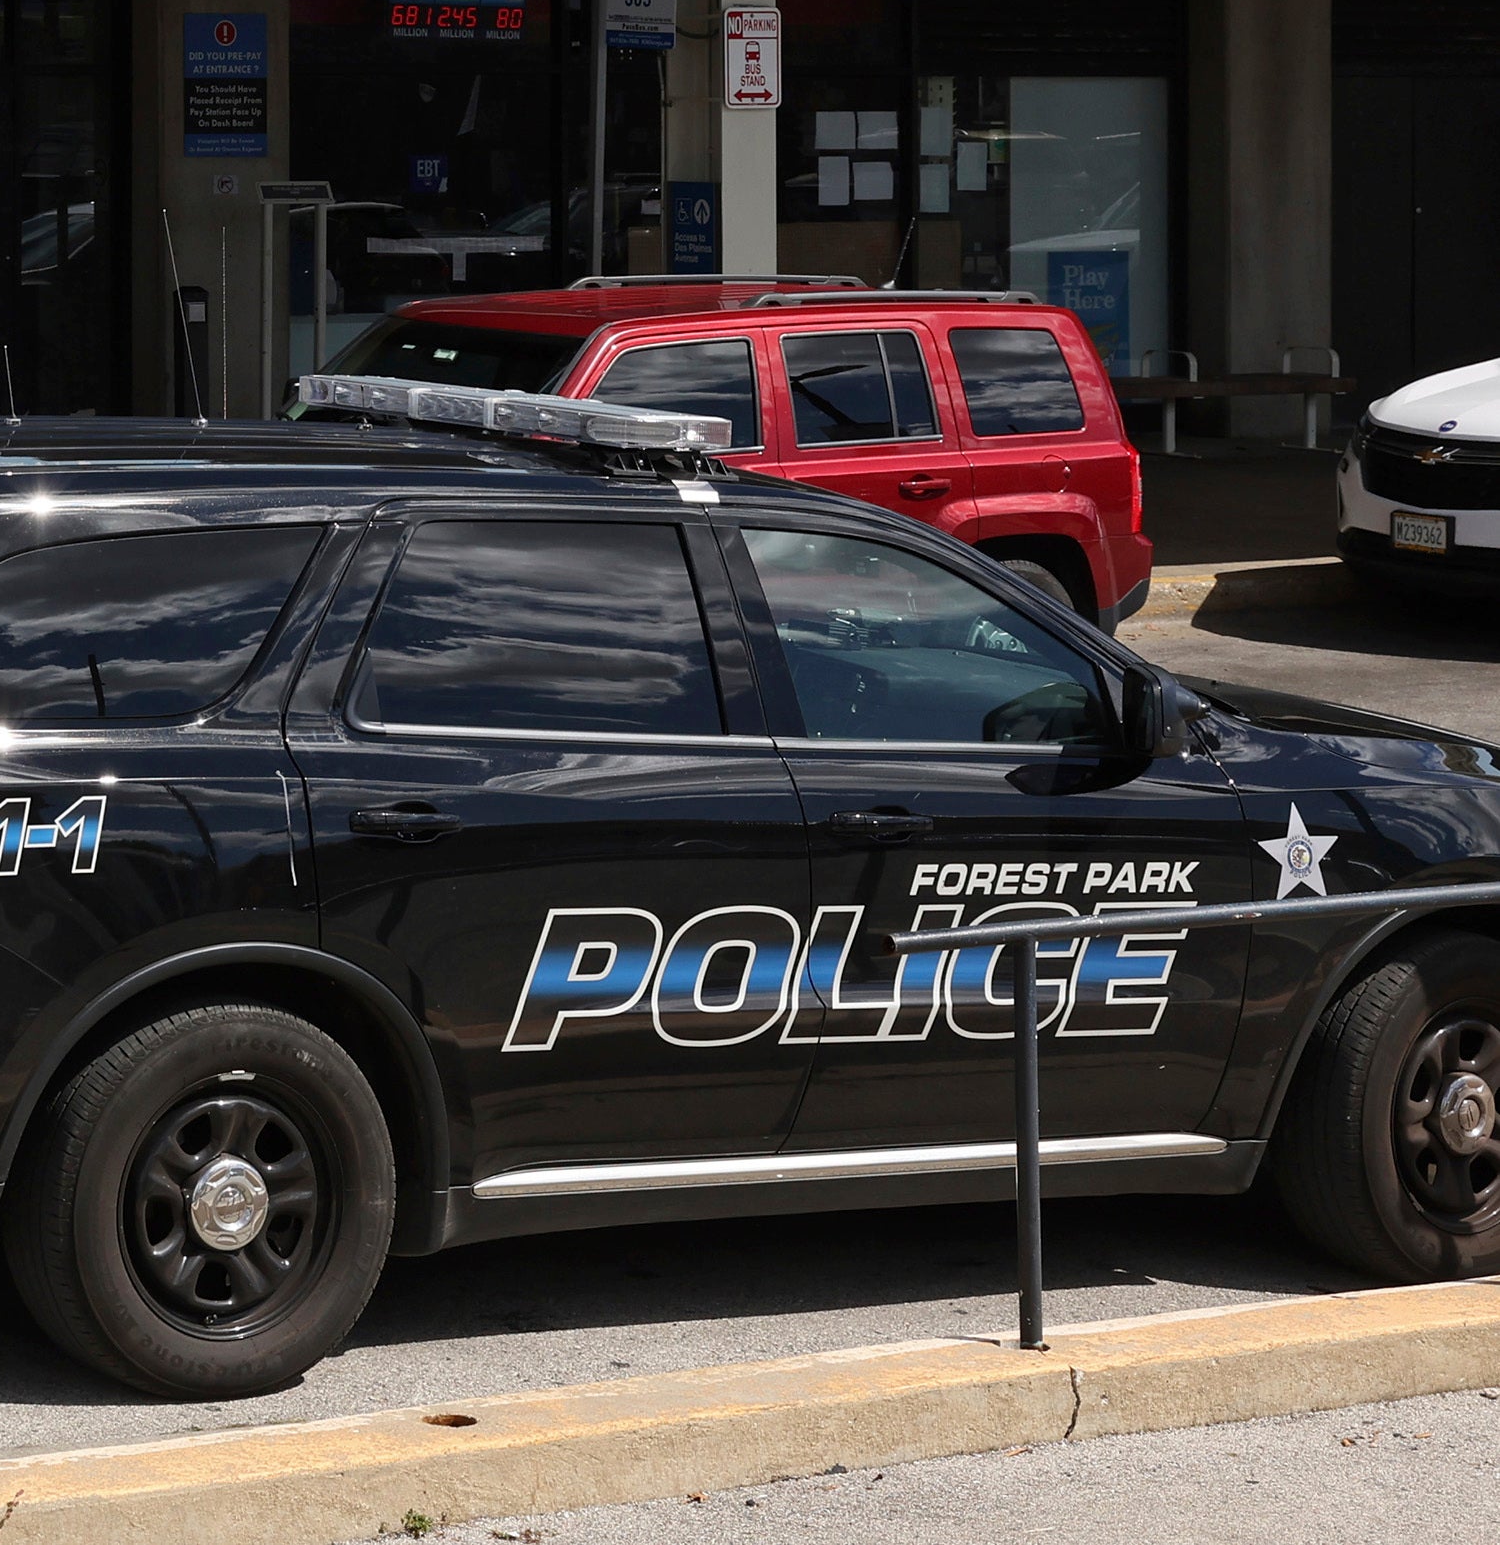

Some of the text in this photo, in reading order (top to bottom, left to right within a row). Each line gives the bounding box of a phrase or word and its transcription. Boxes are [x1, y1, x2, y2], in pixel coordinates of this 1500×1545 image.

[496, 7, 523, 29] 80
[393, 28, 428, 37] MILLION
[728, 17, 777, 35] NO PARKING
[440, 29, 474, 39] MILLION
[486, 30, 520, 40] MILLION
[189, 52, 262, 61] DID YOU PRE-PAY
[193, 65, 204, 74] AT
[206, 65, 252, 74] ENTRANCE
[745, 64, 761, 75] BUS
[740, 76, 766, 87] STAND
[417, 159, 440, 177] EBT
[1063, 265, 1109, 291] Play
[1063, 288, 1116, 310] Here
[909, 860, 1200, 897] FOREST PARK
[501, 900, 1198, 1053] POLICE
